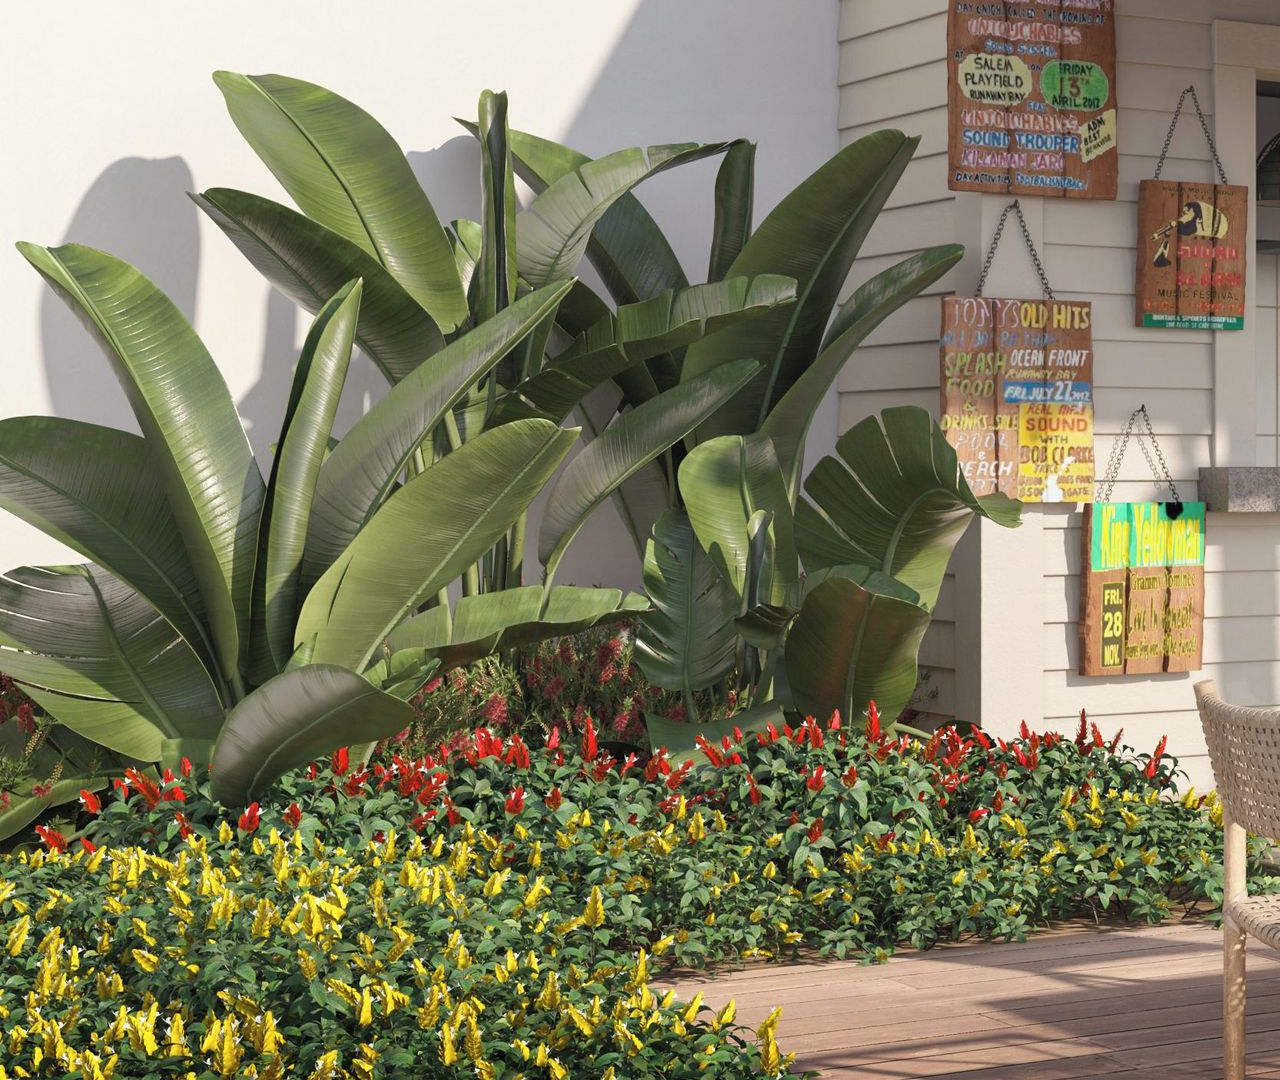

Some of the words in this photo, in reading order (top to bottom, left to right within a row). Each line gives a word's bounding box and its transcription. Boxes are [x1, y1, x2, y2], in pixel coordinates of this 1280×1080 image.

[974, 56, 1014, 71] SALEM
[1058, 62, 1094, 76] FRIDAY
[962, 128, 1010, 149] SOUND
[1015, 132, 1079, 154] TROOPER
[1158, 288, 1189, 299] MUSIC
[1193, 289, 1239, 301] FESTIVAL
[1020, 302, 1048, 329] OLD
[1052, 304, 1090, 330] HITS
[945, 351, 1008, 377] SPLASH
[1010, 349, 1045, 366] OCEAN
[1048, 349, 1089, 367] FRONT
[946, 376, 995, 398] FOOD
[1025, 418, 1088, 433] SOUND
[1040, 434, 1069, 445] WITH
[1020, 444, 1048, 464] BOB
[1101, 503, 1130, 569] King
[1133, 501, 1200, 567] Yellowman
[1103, 611, 1122, 638] 28
